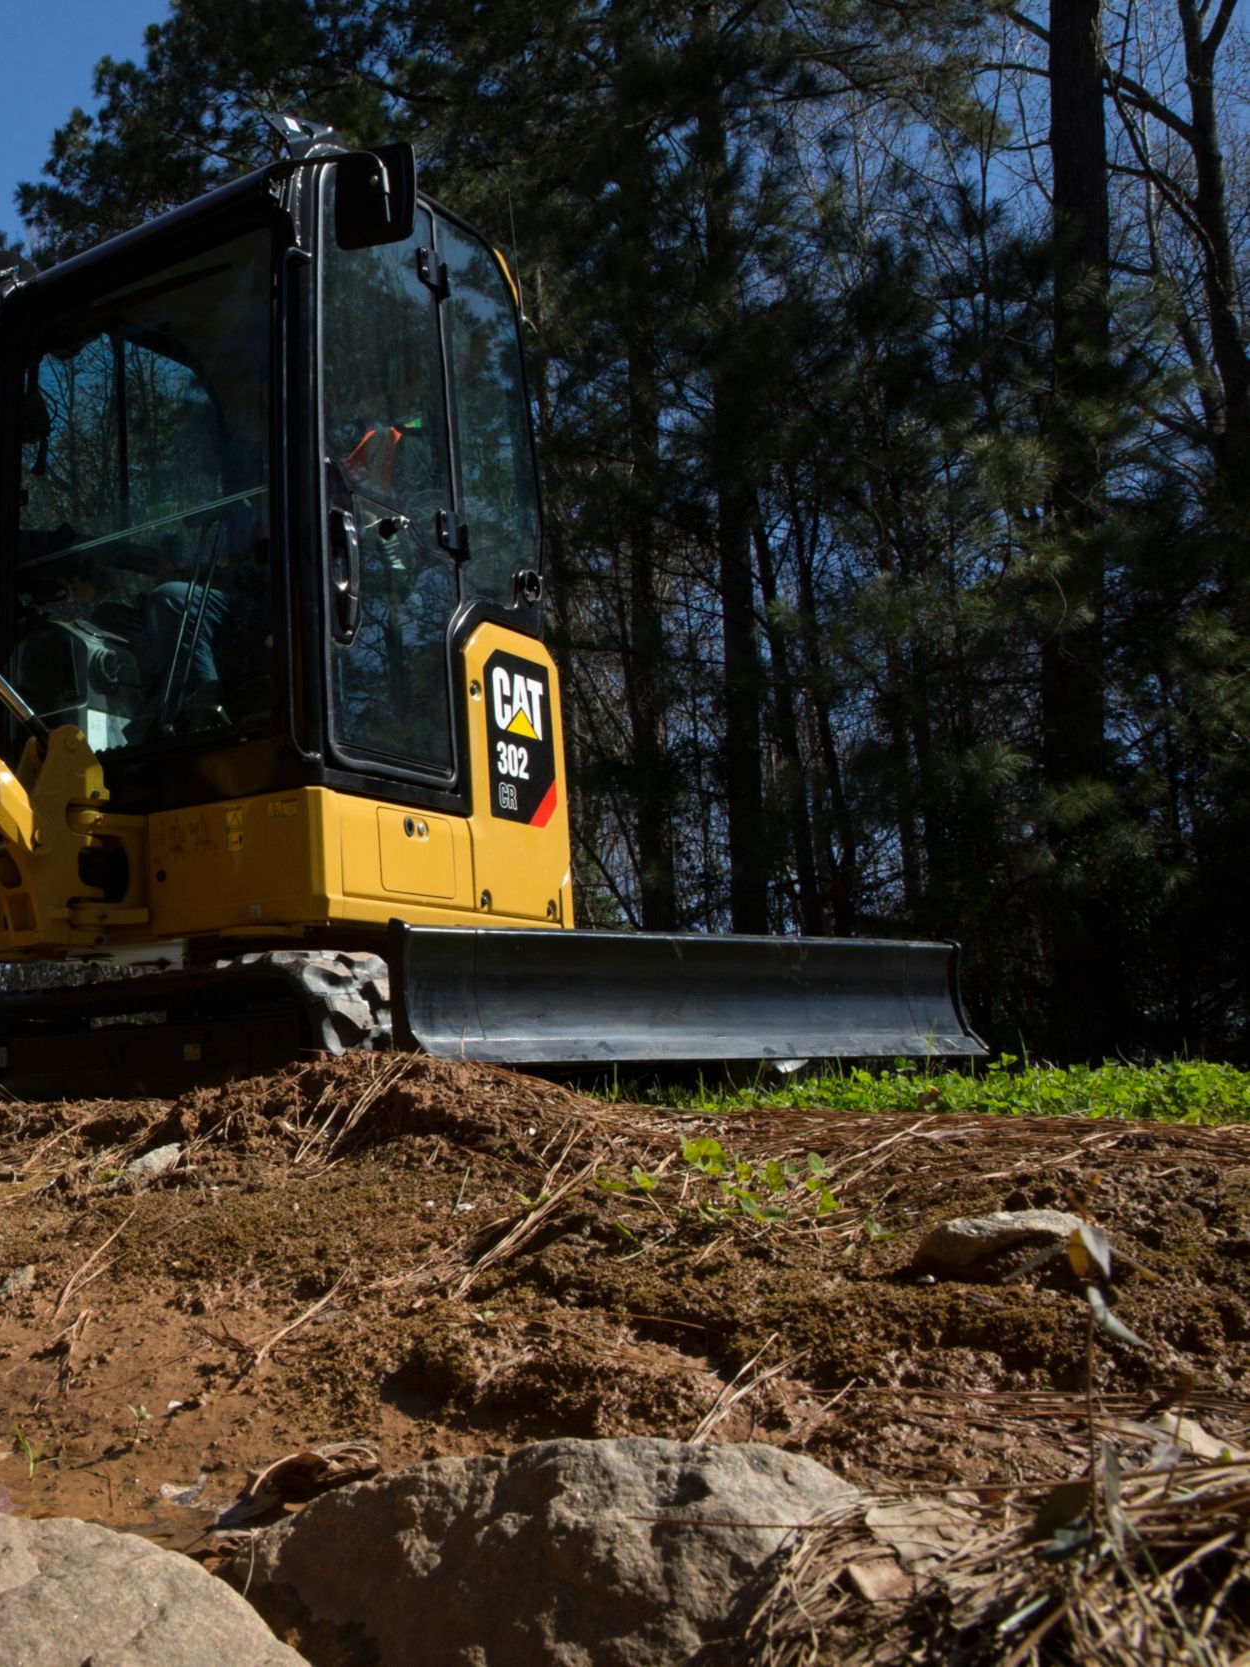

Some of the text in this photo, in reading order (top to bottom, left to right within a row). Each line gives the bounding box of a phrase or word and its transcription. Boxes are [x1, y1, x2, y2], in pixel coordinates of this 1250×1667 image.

[491, 666, 544, 741] CAT
[496, 741, 530, 781] 302
[499, 781, 519, 811] CR
